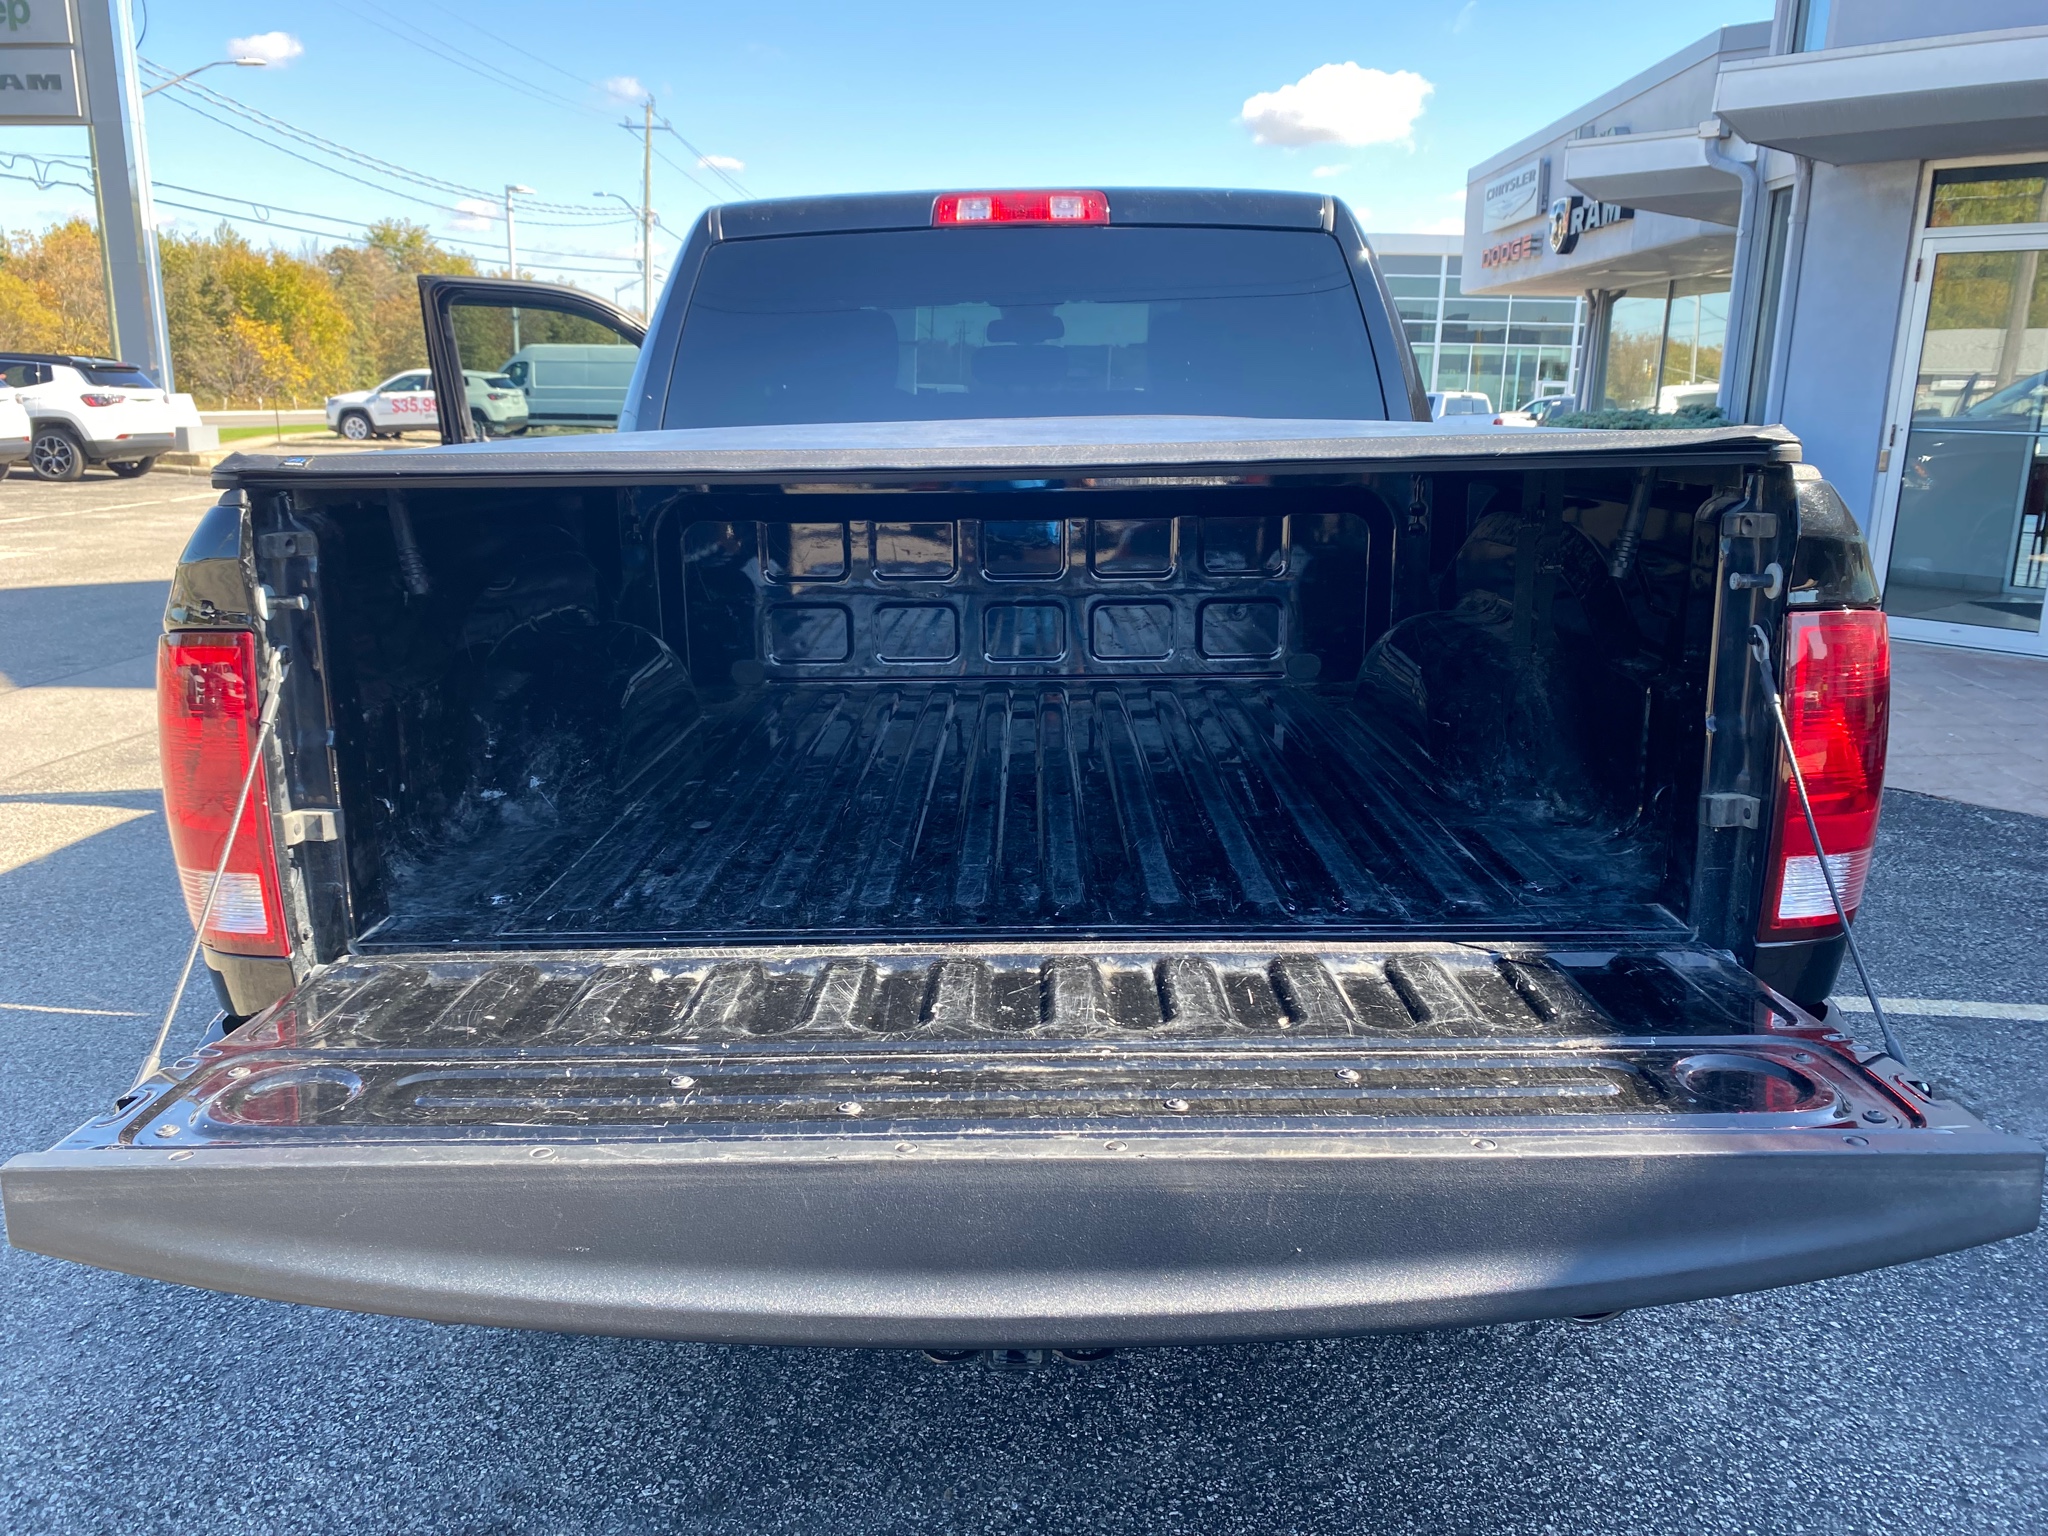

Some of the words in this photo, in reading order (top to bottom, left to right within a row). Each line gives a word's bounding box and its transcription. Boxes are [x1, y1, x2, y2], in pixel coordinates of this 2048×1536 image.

[1486, 169, 1536, 202] CHRYSLER
[1570, 201, 1621, 236] RAM
[1482, 234, 1532, 268] DODGE
